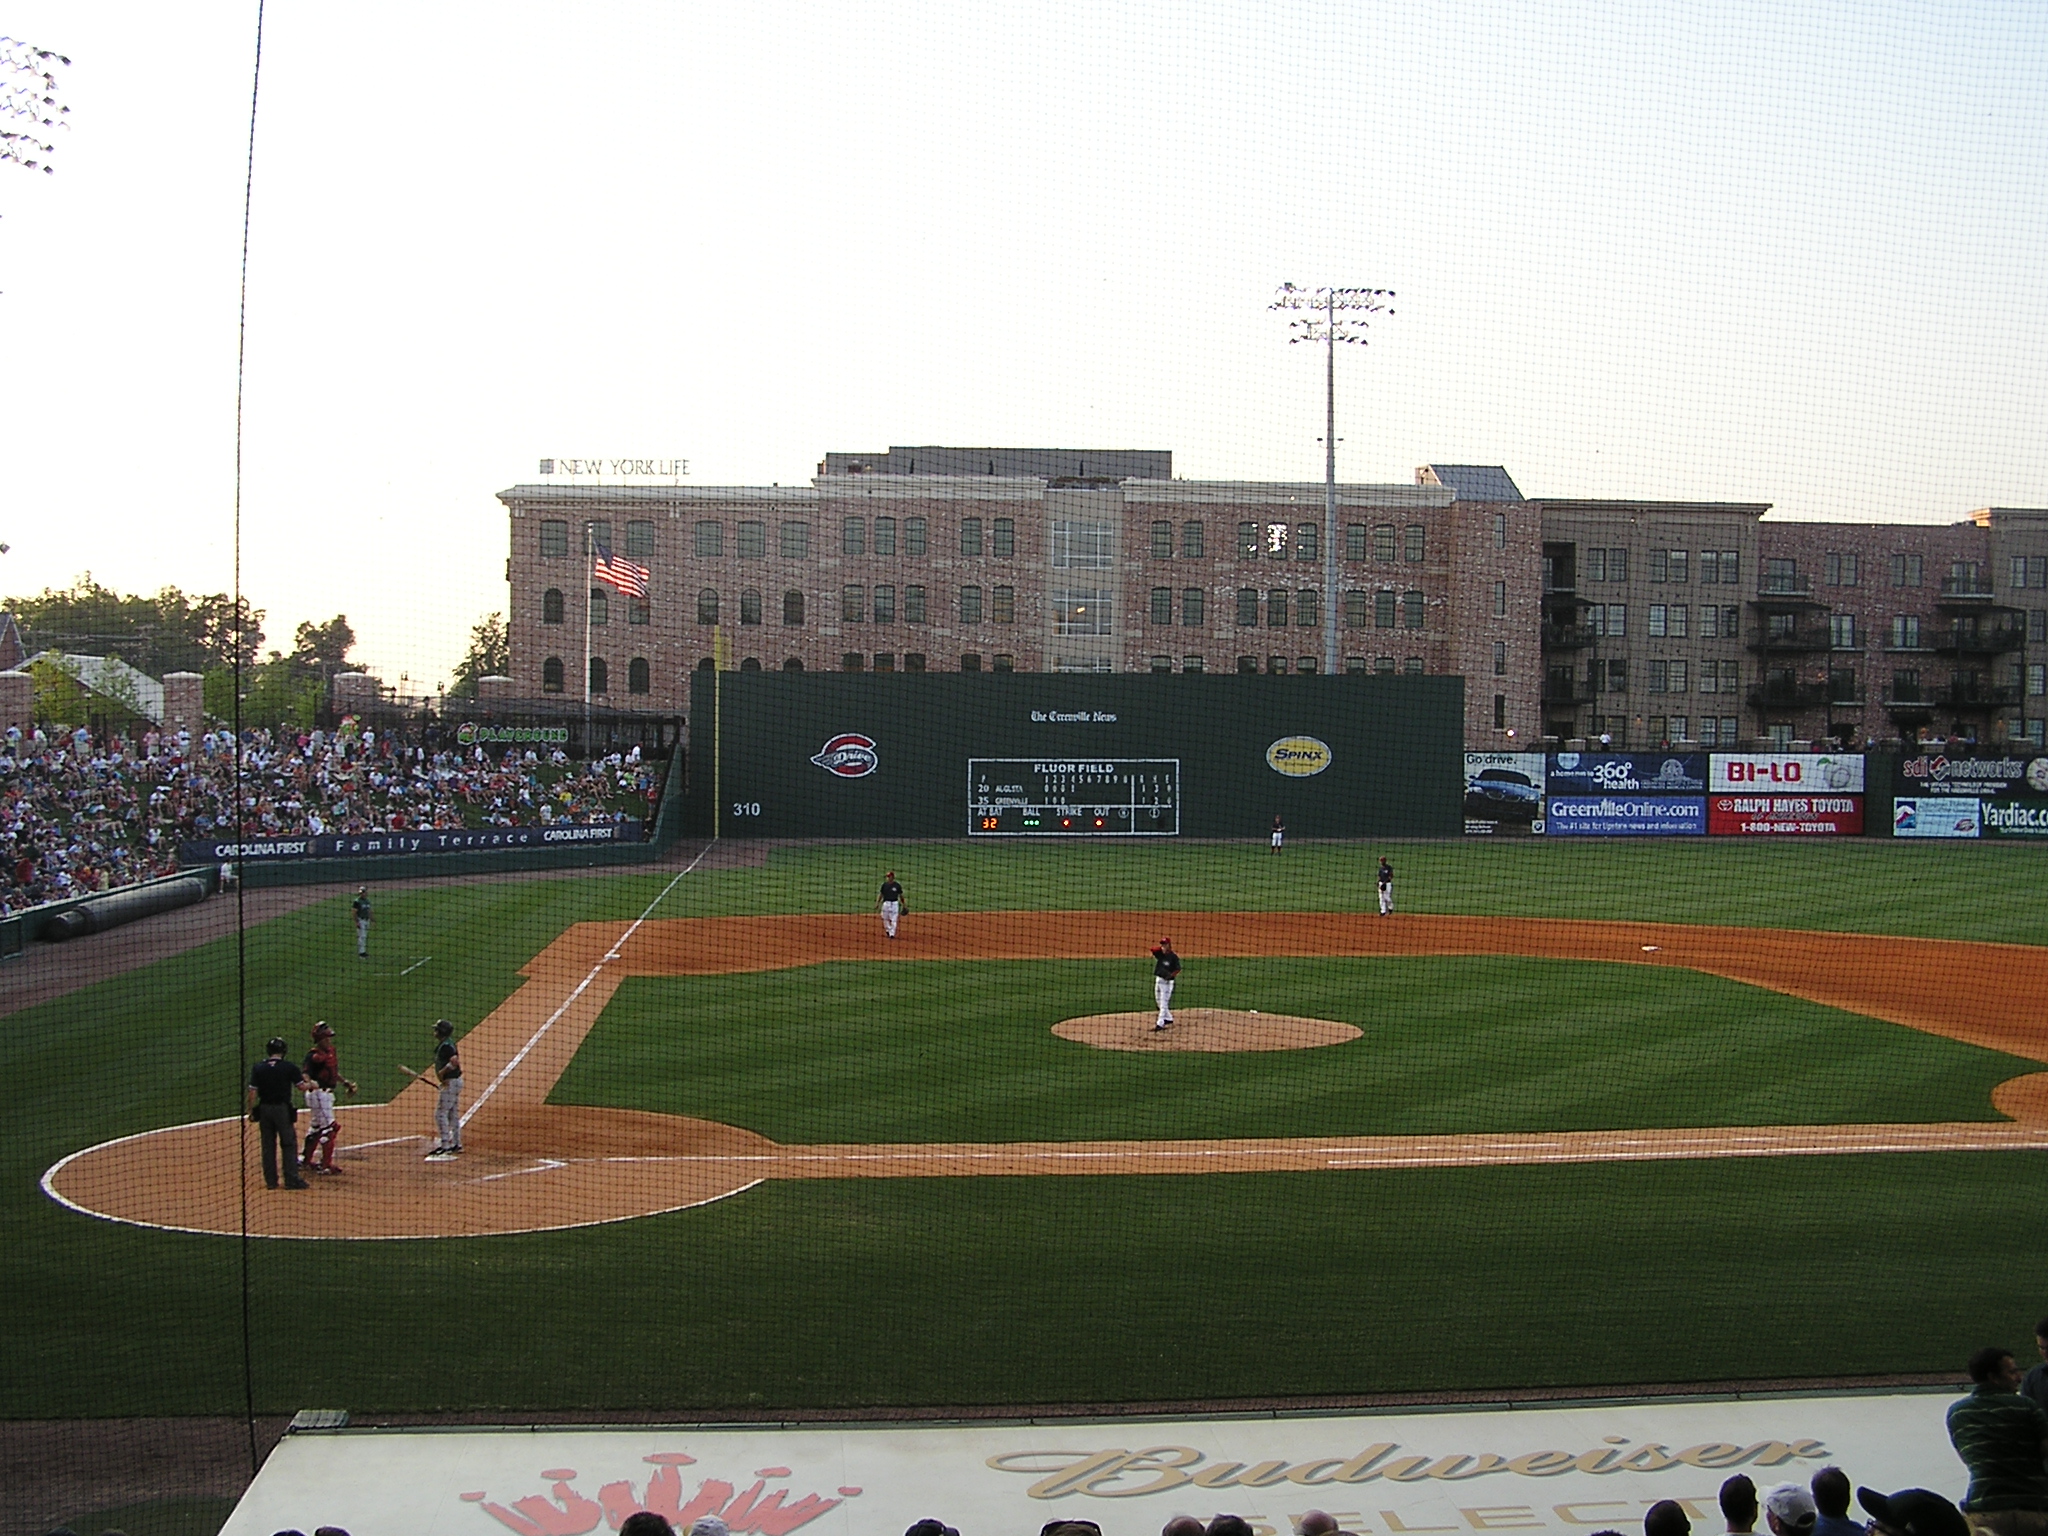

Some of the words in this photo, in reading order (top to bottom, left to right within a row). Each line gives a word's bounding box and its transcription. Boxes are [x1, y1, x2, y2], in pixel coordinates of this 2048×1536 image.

[560, 459, 602, 475] NEW
[610, 459, 656, 475] YORK
[659, 459, 690, 475] LIFE
[1031, 710, 1047, 722] The
[480, 726, 568, 742] PLAYGROUND
[833, 751, 871, 765] Drive
[1274, 748, 1324, 761] SPINX
[1466, 753, 1483, 765] Go
[1485, 754, 1517, 765] drive.
[1034, 763, 1076, 773] FLUOR
[1078, 763, 1114, 773] FIELD
[1727, 762, 1802, 783] BI-LO
[1903, 756, 1928, 778] sdi
[1951, 757, 2022, 778] networks
[978, 784, 990, 793] 20
[1603, 778, 1640, 790] health
[977, 796, 989, 805] 35
[1733, 799, 1770, 812] RALPH
[1773, 799, 1808, 812] HAYES
[1811, 799, 1854, 812] TOYOTA
[733, 803, 761, 816] 310
[1022, 806, 1040, 816] BALL
[1056, 806, 1082, 816] STRIKE
[1093, 806, 1110, 816] OUT
[1551, 800, 1699, 817] GreenvilleOnline.com
[982, 818, 997, 829] 32
[1740, 823, 1836, 832] 1-800-NEW-TOYOTA
[543, 829, 589, 842] CAROLINA
[589, 828, 613, 839] FIRST
[215, 843, 275, 857] CAROLINA
[276, 841, 306, 854] FIRST
[336, 836, 421, 852] Family
[438, 833, 529, 847] Terrace
[986, 1435, 1833, 1499] Budweiser
